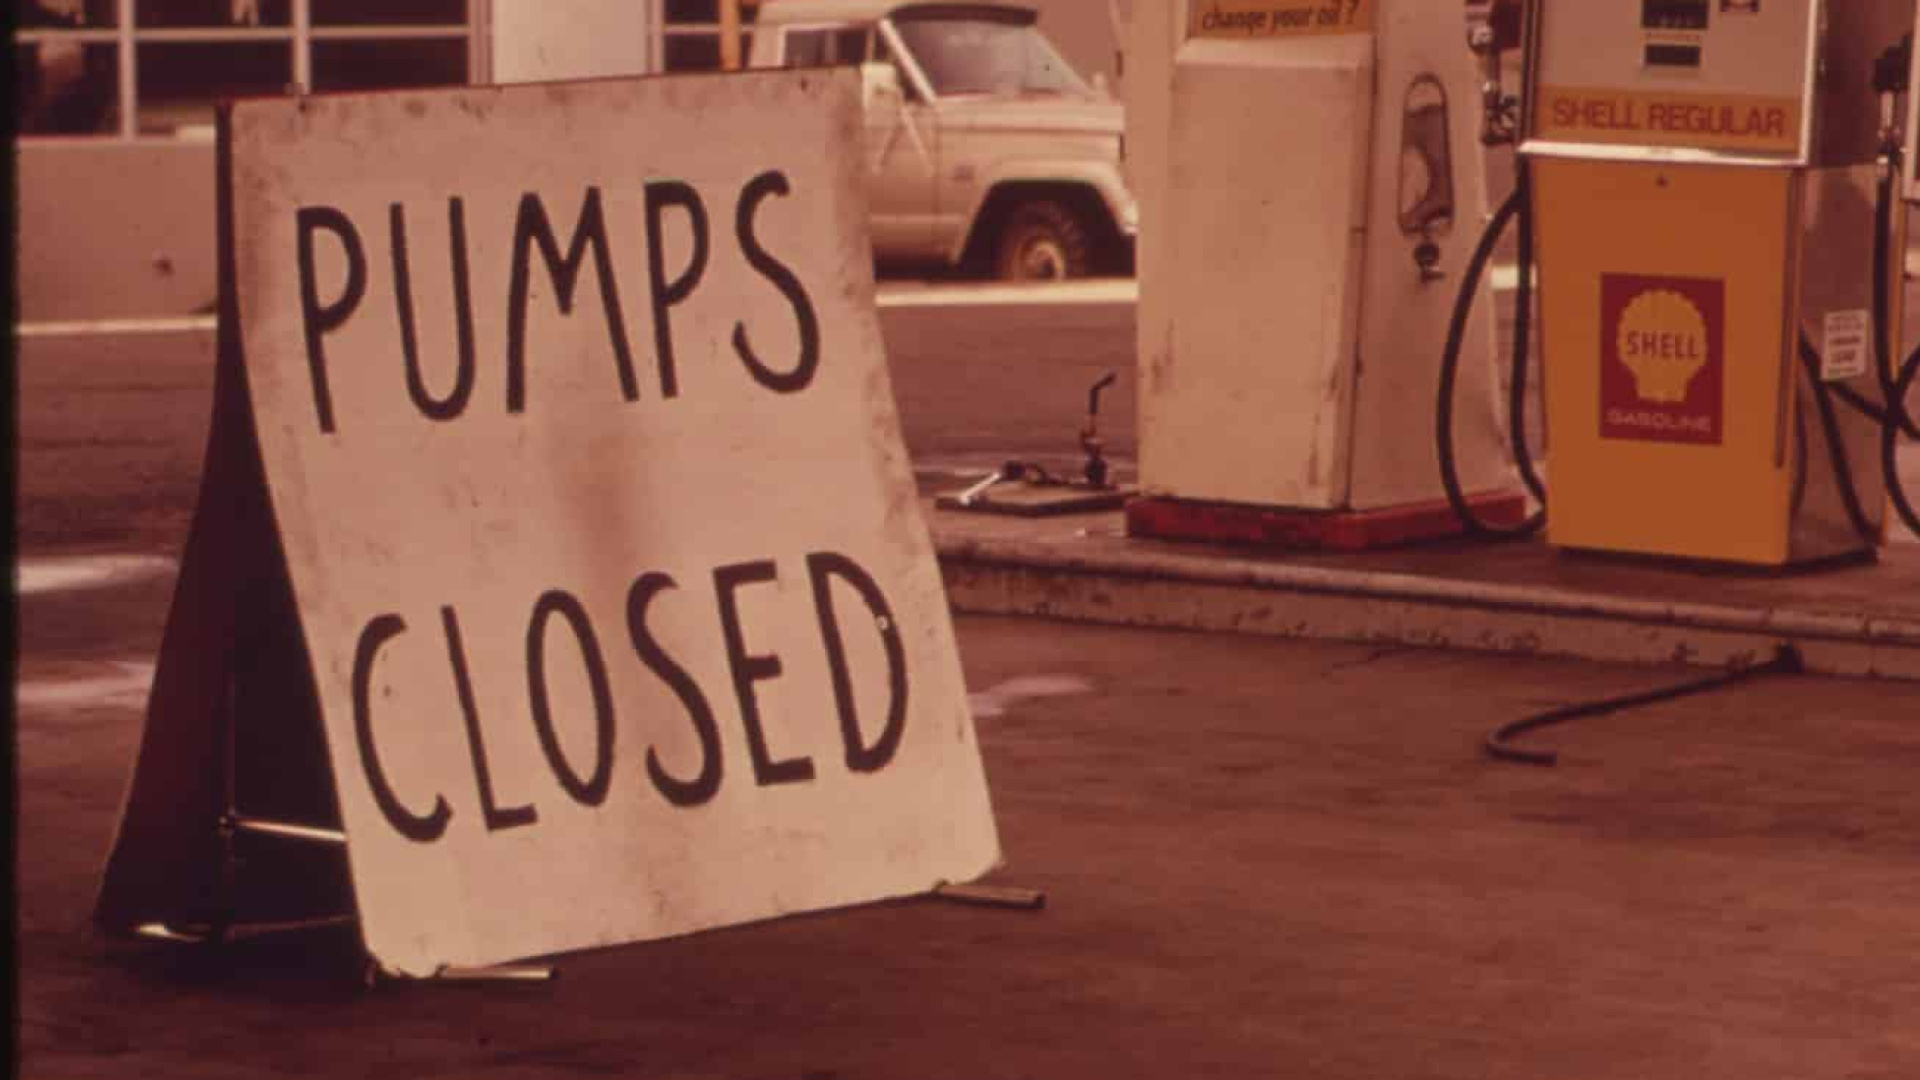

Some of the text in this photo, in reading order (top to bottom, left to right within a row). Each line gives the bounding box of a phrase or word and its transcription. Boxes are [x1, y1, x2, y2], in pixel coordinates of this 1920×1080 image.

[1202, 4, 1267, 35] change
[1272, 8, 1313, 33] your
[1553, 97, 1785, 138] SHELL REGULAR
[296, 170, 819, 433] PUMPS
[1627, 331, 1701, 360] SHELL
[1606, 408, 1712, 433] GASOLINE
[352, 551, 906, 842] CLOSED
